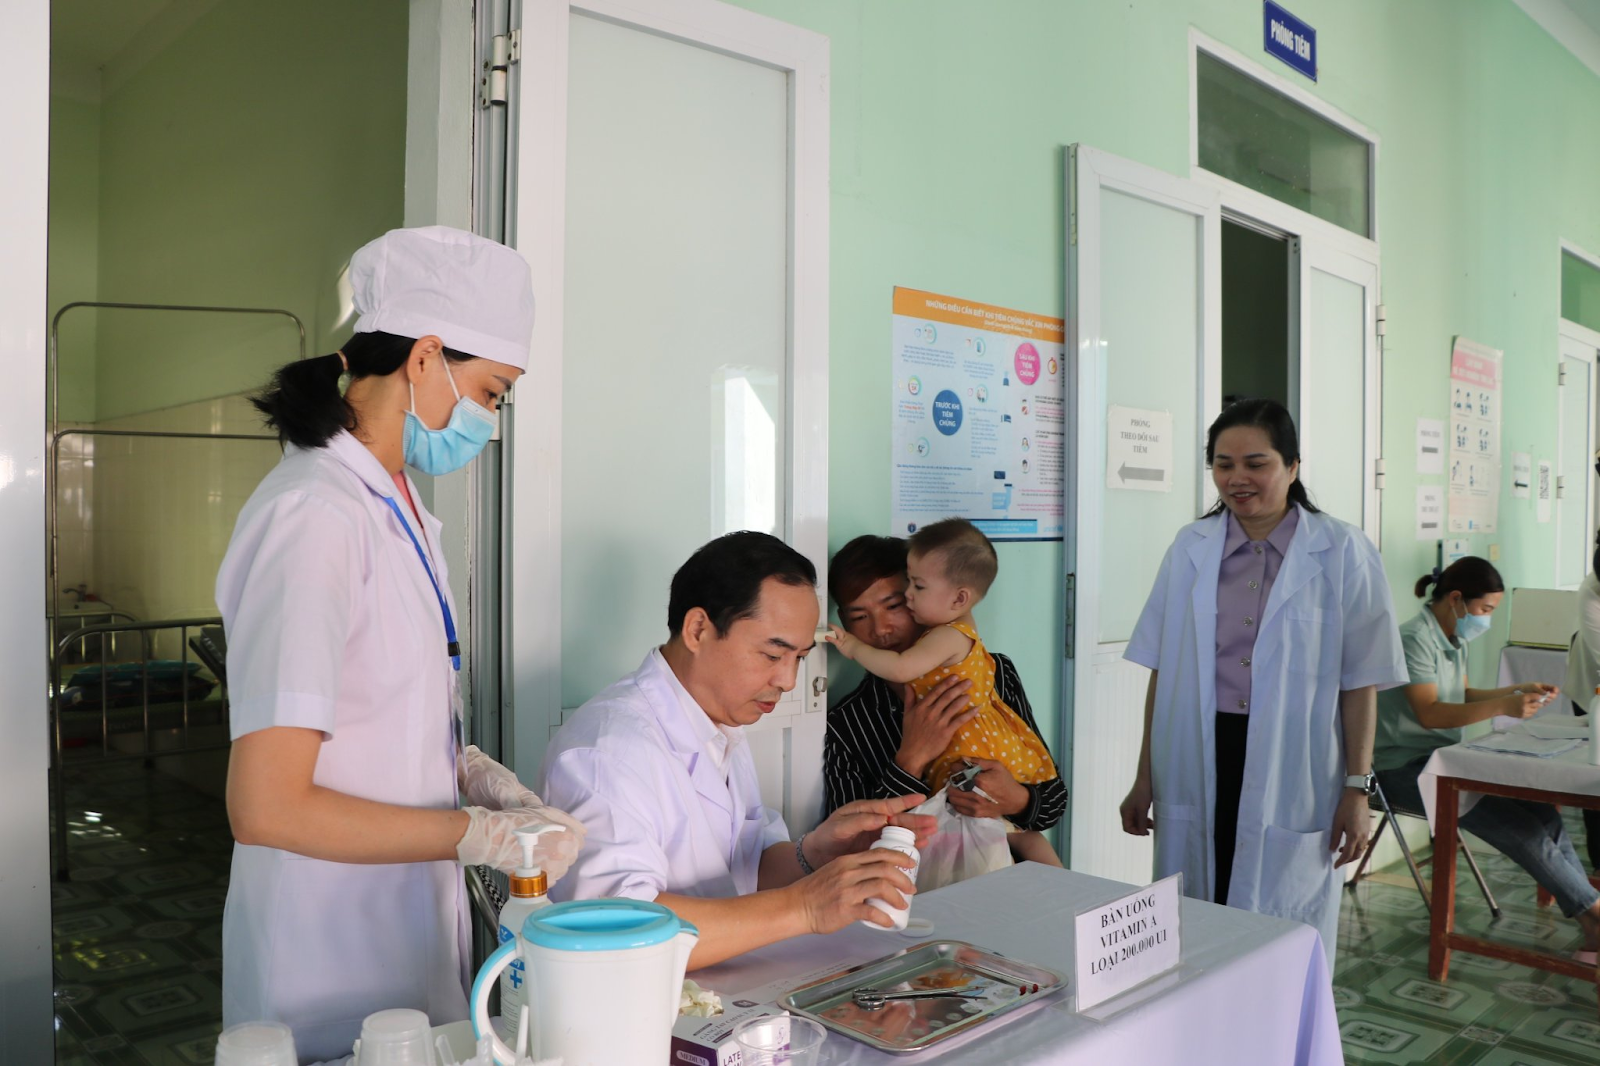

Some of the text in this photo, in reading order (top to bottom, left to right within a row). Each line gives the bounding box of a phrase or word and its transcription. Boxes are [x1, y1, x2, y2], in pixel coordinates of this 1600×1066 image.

[1270, 19, 1311, 61] PHÒNG TIÊM
[926, 299, 947, 311] NHỮNG
[1022, 360, 1033, 369] TIÊM
[1019, 369, 1036, 378] CHỦNG
[935, 401, 951, 410] TRƯỚC
[942, 410, 954, 418] TIÊM
[939, 418, 957, 427] CHỦNG
[1130, 417, 1151, 428] PHÒNG
[1120, 431, 1137, 440] THEO
[1148, 434, 1159, 443] SAU
[1132, 443, 1148, 454] TIÊM
[1100, 893, 1156, 928] BÀN UỐNG
[1100, 914, 1158, 948] VITAMIN A
[1090, 928, 1167, 975] LOẠI 200.000 UI
[679, 1050, 706, 1066] MEDIUM
